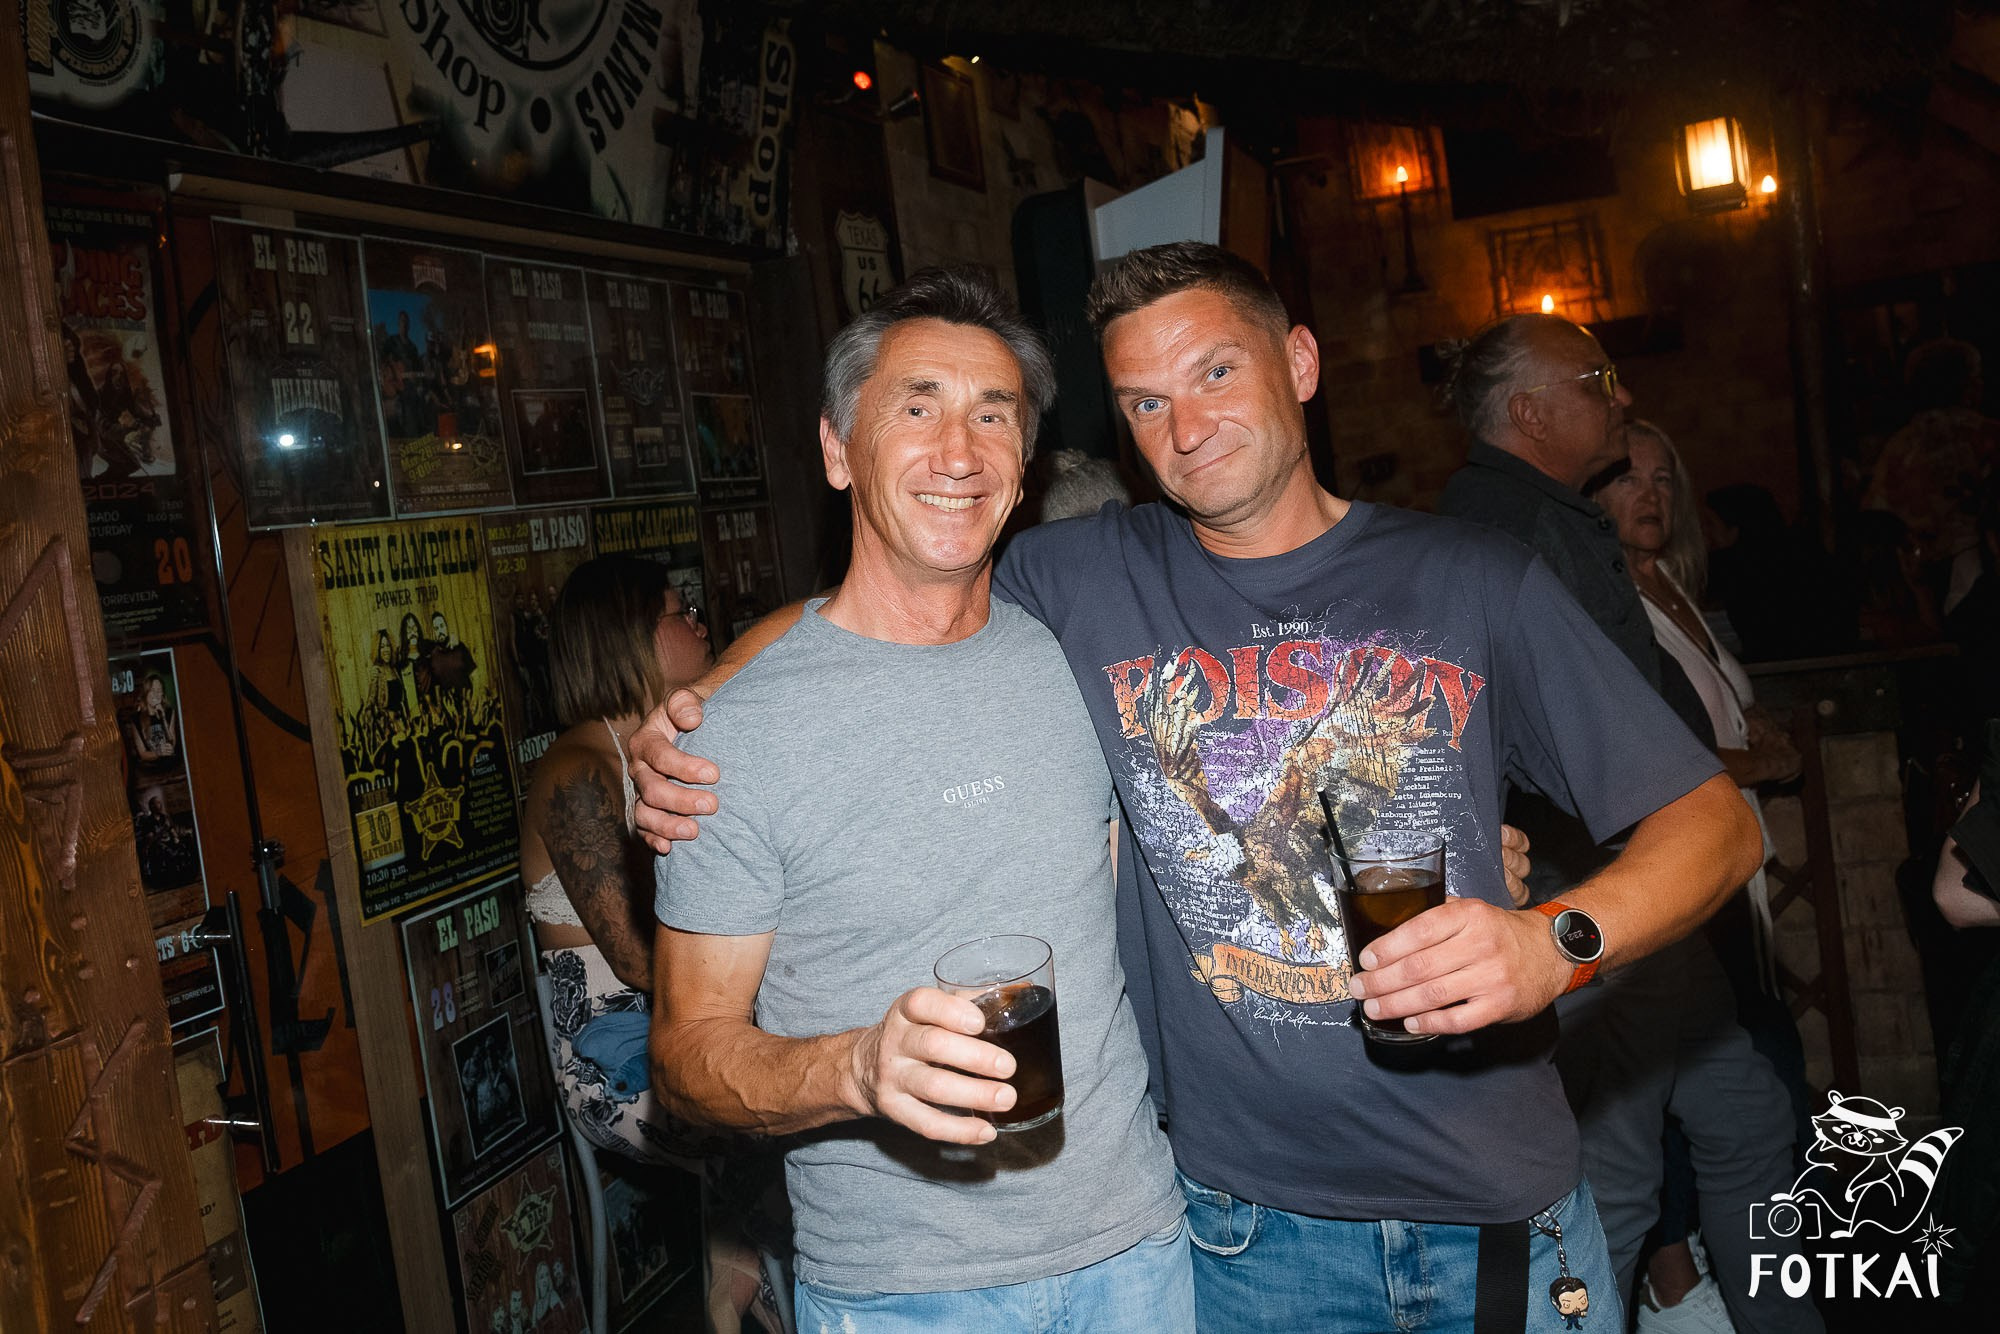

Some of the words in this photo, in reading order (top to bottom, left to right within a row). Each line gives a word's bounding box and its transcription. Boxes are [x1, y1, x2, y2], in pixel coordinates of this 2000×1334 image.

[749, 40, 793, 217] Shop
[251, 233, 278, 271] EL
[283, 237, 329, 277] PASO
[284, 301, 316, 345] 22
[88, 510, 120, 523] BADO
[88, 522, 134, 538] TURDAY
[529, 518, 550, 552] EL
[549, 513, 587, 549] PASO
[594, 510, 637, 554] SANTI
[636, 504, 698, 550] CAMPILLO
[153, 536, 193, 585] 20
[319, 536, 386, 591] SANTI
[386, 527, 479, 583] CAMPILLO
[101, 590, 160, 607] ORREVIEJA
[375, 587, 413, 610] POWER
[1250, 623, 1275, 639] Est.
[1277, 621, 1309, 636] 1990
[1102, 638, 1486, 753] POISON
[1419, 764, 1454, 774] Freiheit
[943, 775, 1005, 803] GUESS
[366, 809, 393, 847] 10
[366, 867, 390, 886] 10:30
[436, 914, 459, 952] EL
[463, 896, 500, 940] PASO
[431, 979, 458, 1032] 28
